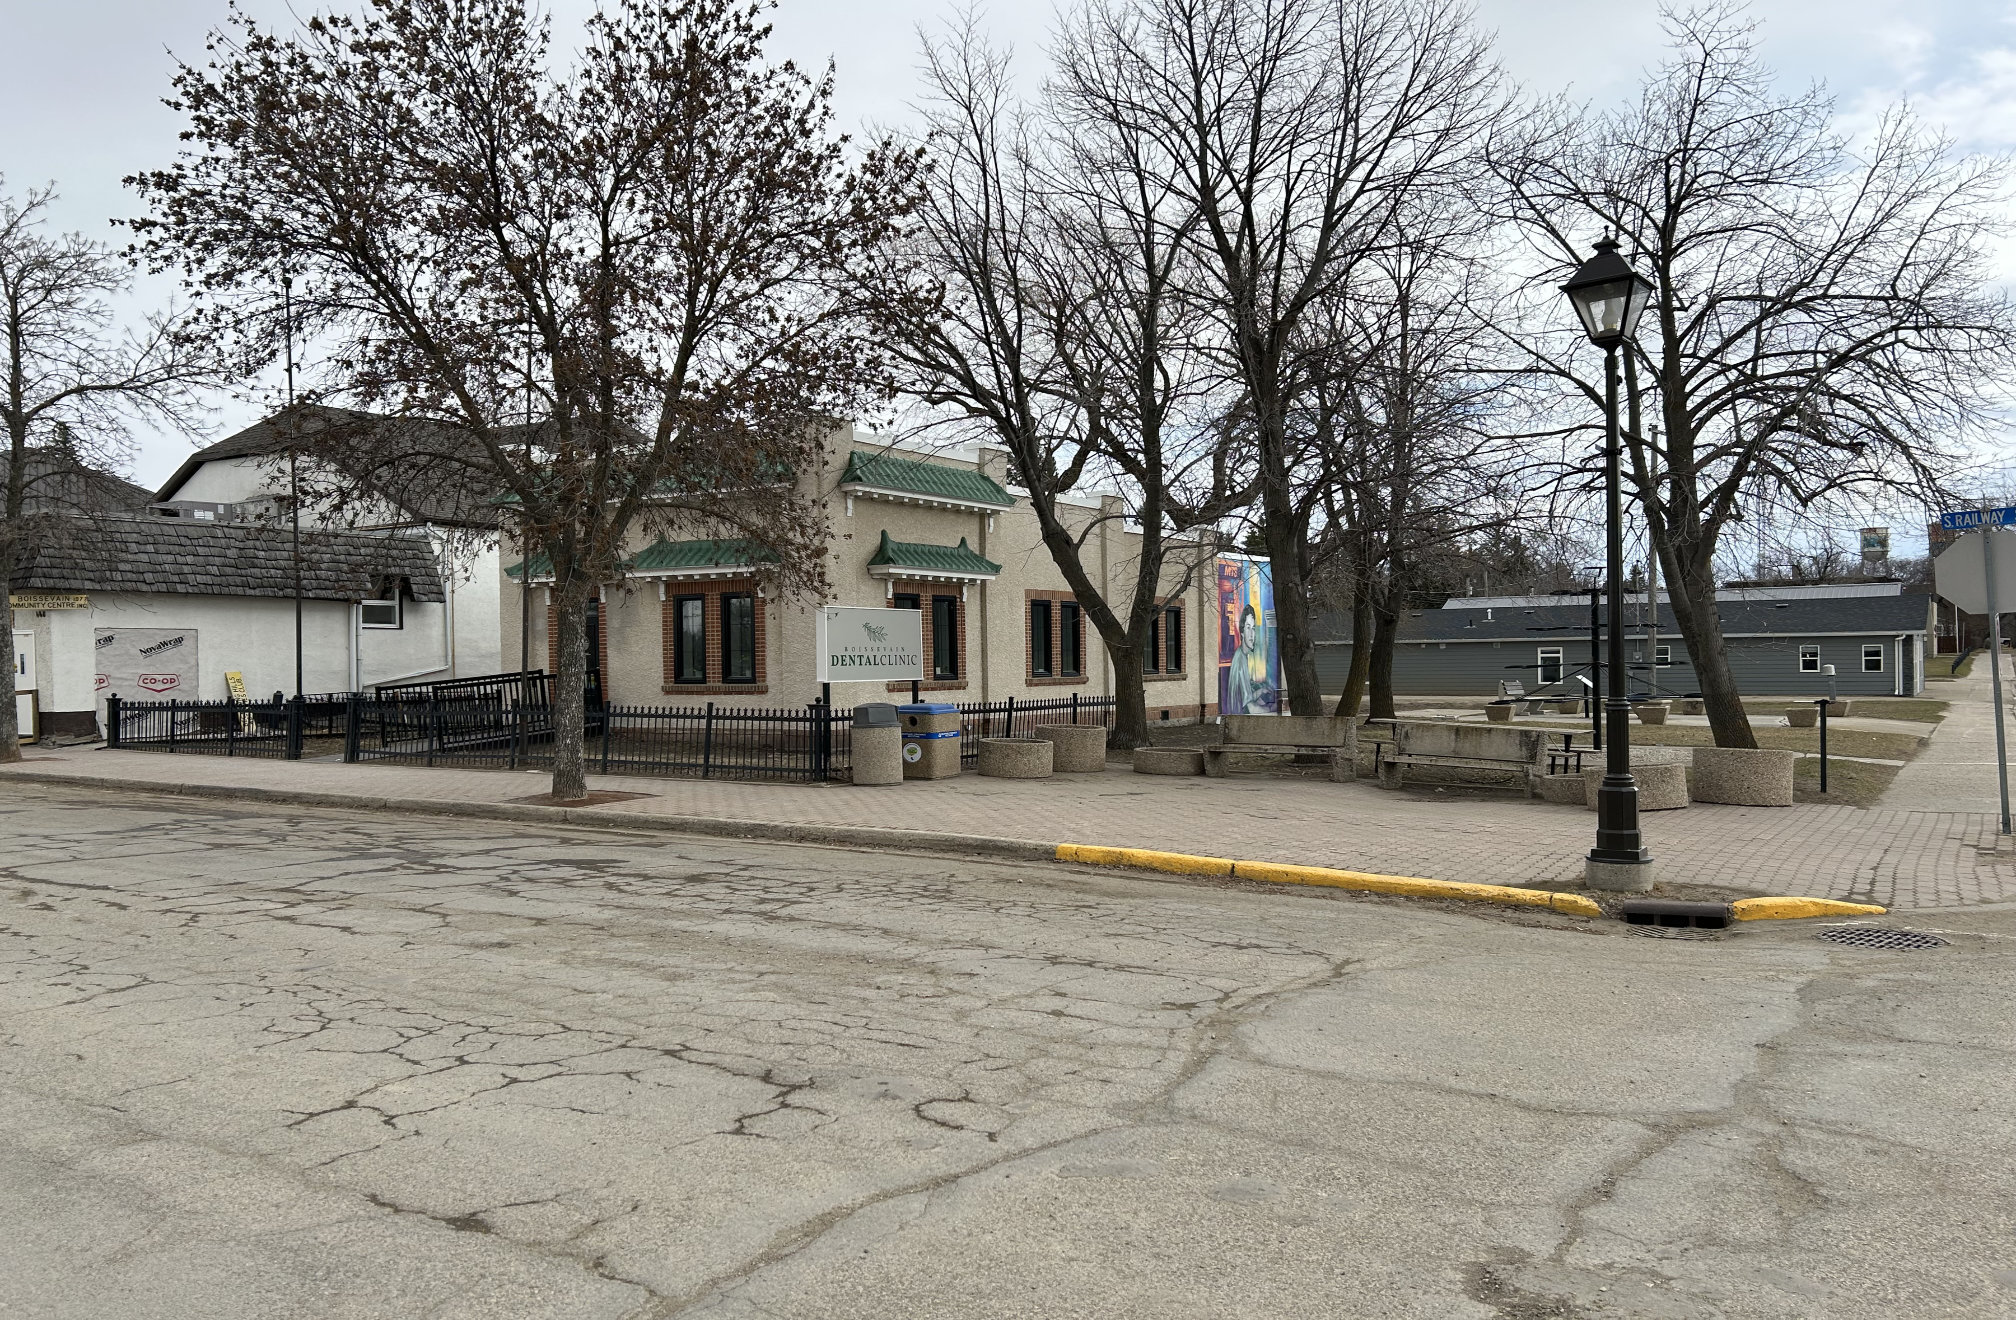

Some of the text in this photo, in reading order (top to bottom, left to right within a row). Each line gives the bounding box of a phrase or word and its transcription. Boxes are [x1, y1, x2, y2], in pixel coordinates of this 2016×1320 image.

[1955, 511, 2006, 526] RAILWAY
[1224, 566, 1238, 577] MTS
[139, 636, 184, 656] NovaWrap
[142, 677, 176, 685] CO-OP
[235, 678, 245, 693] CLUB
